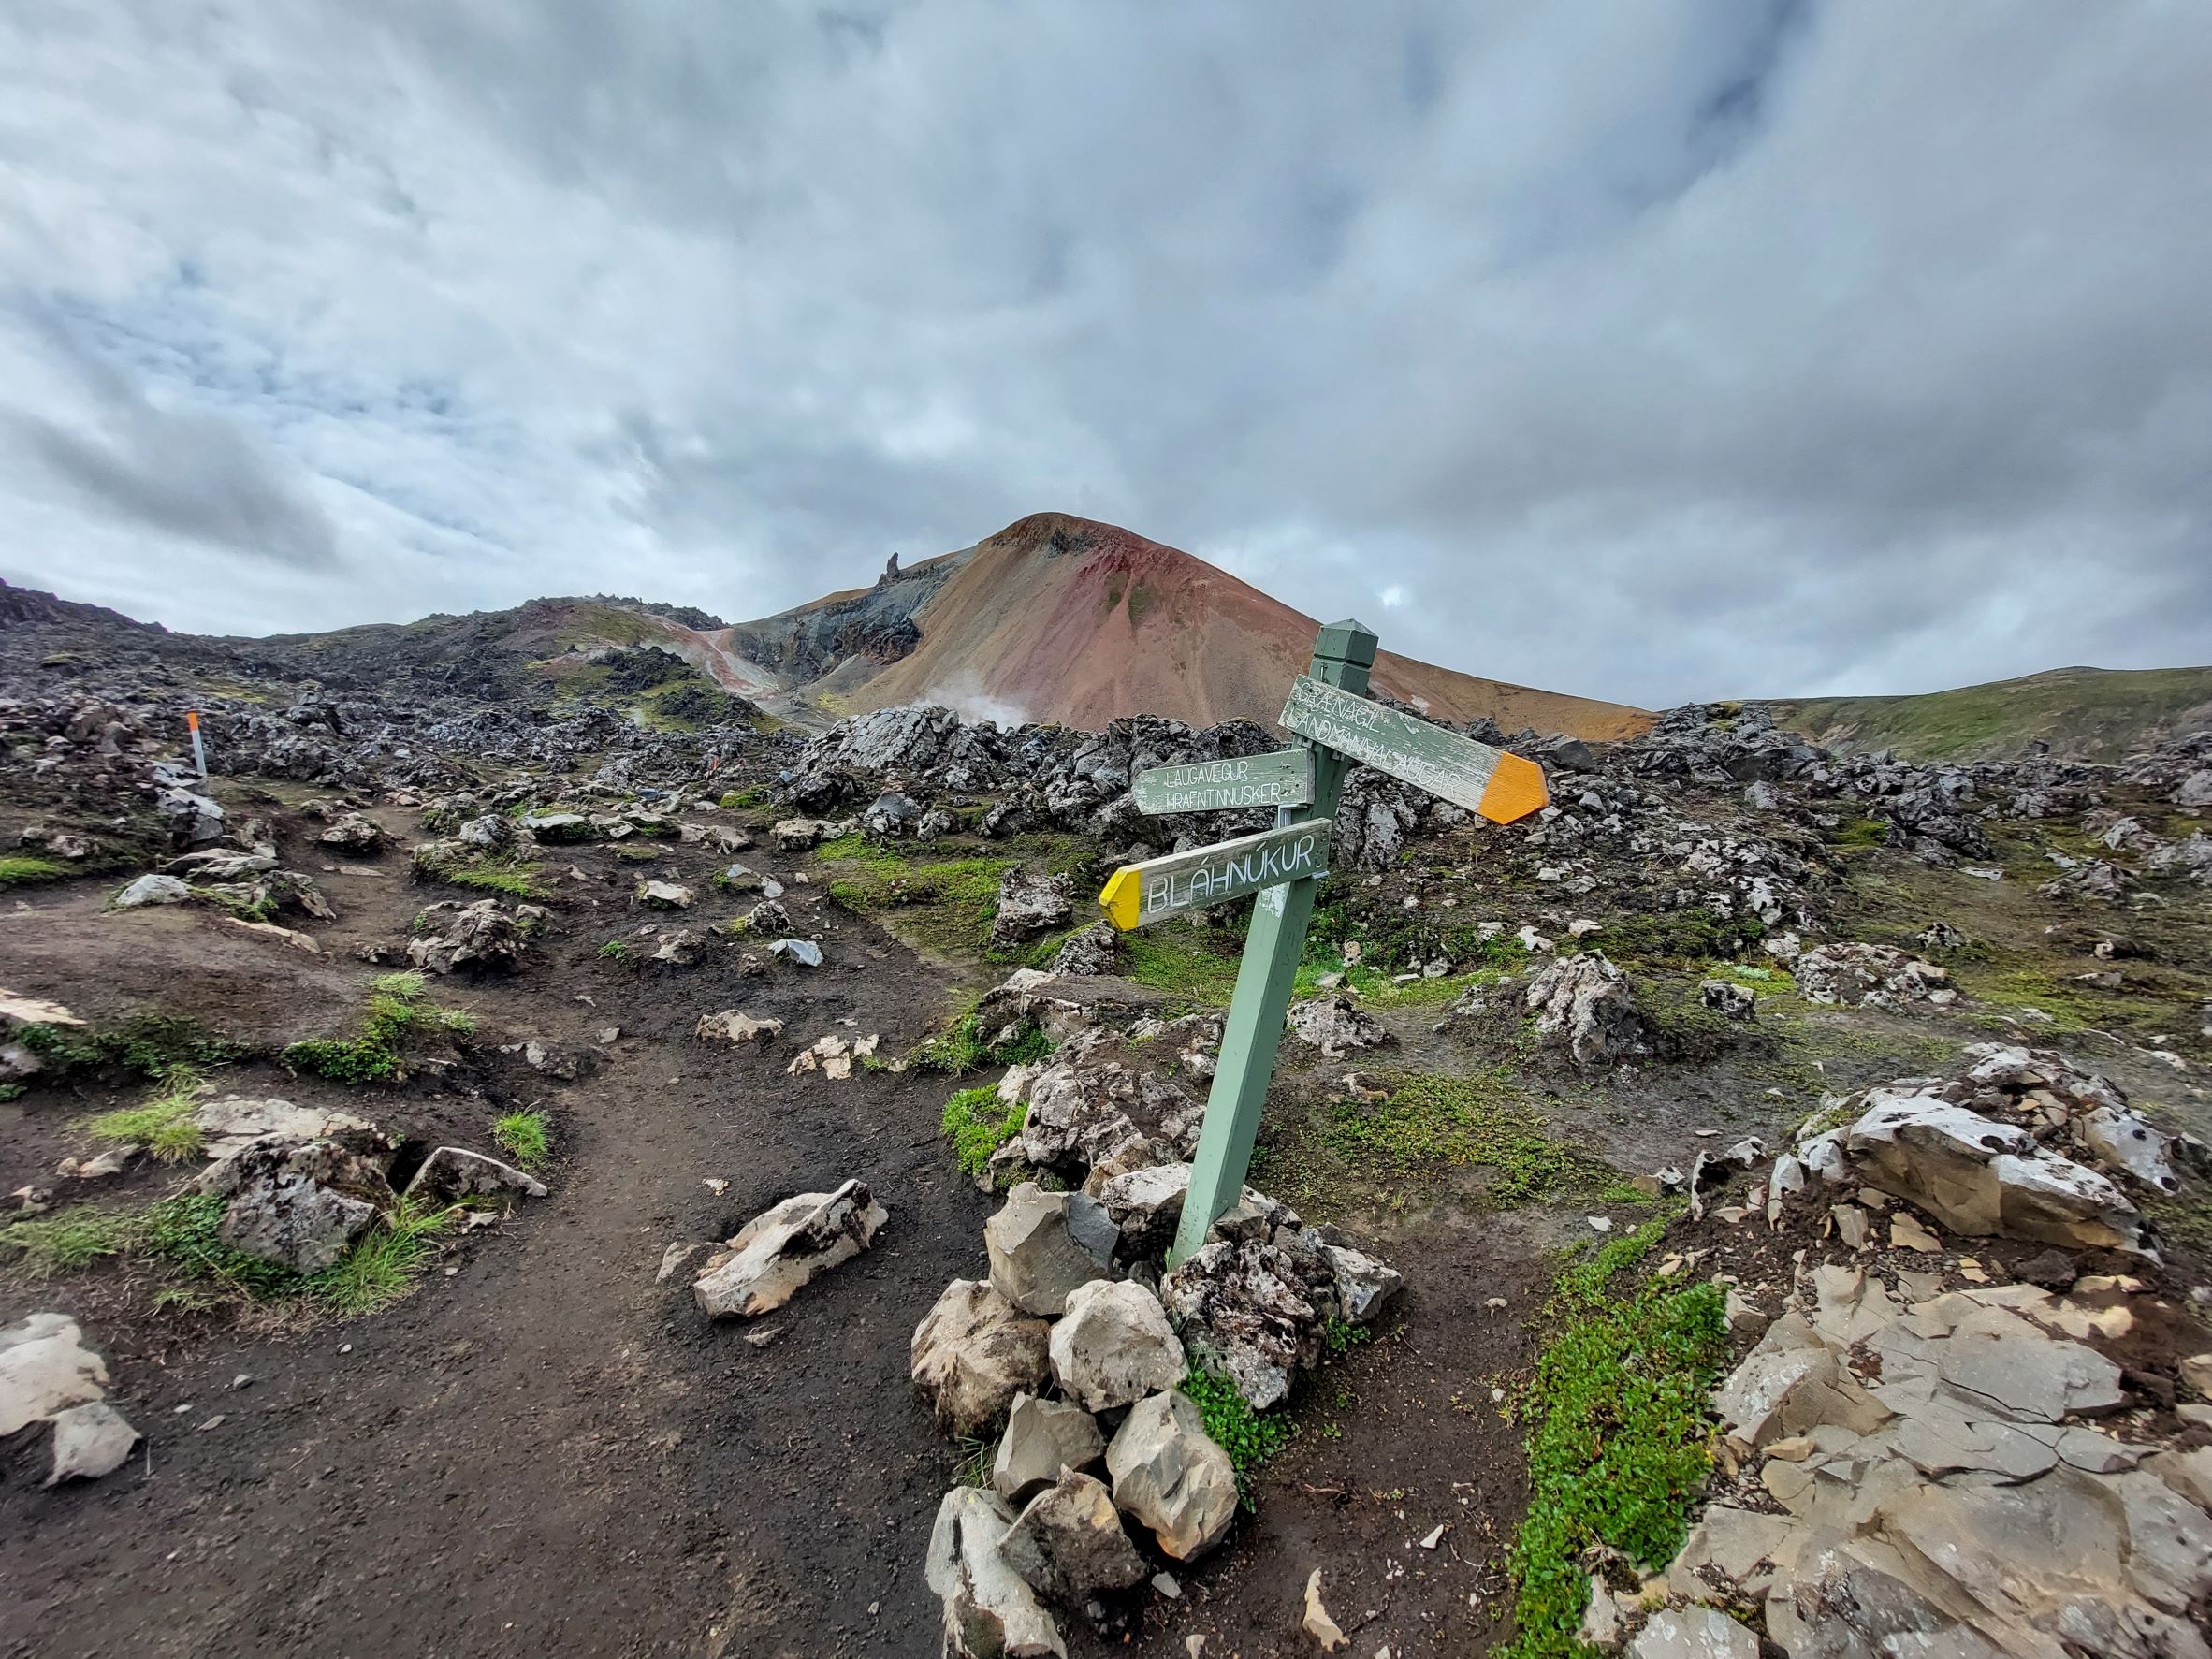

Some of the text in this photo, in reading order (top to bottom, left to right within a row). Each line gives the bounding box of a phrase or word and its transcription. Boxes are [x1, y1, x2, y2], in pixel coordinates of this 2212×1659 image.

[1165, 761, 1248, 788] LAUGAVEGUR
[1167, 783, 1281, 810] HRAFNTINNUSKER
[1147, 836, 1315, 914] BLÁHNÚKUR
